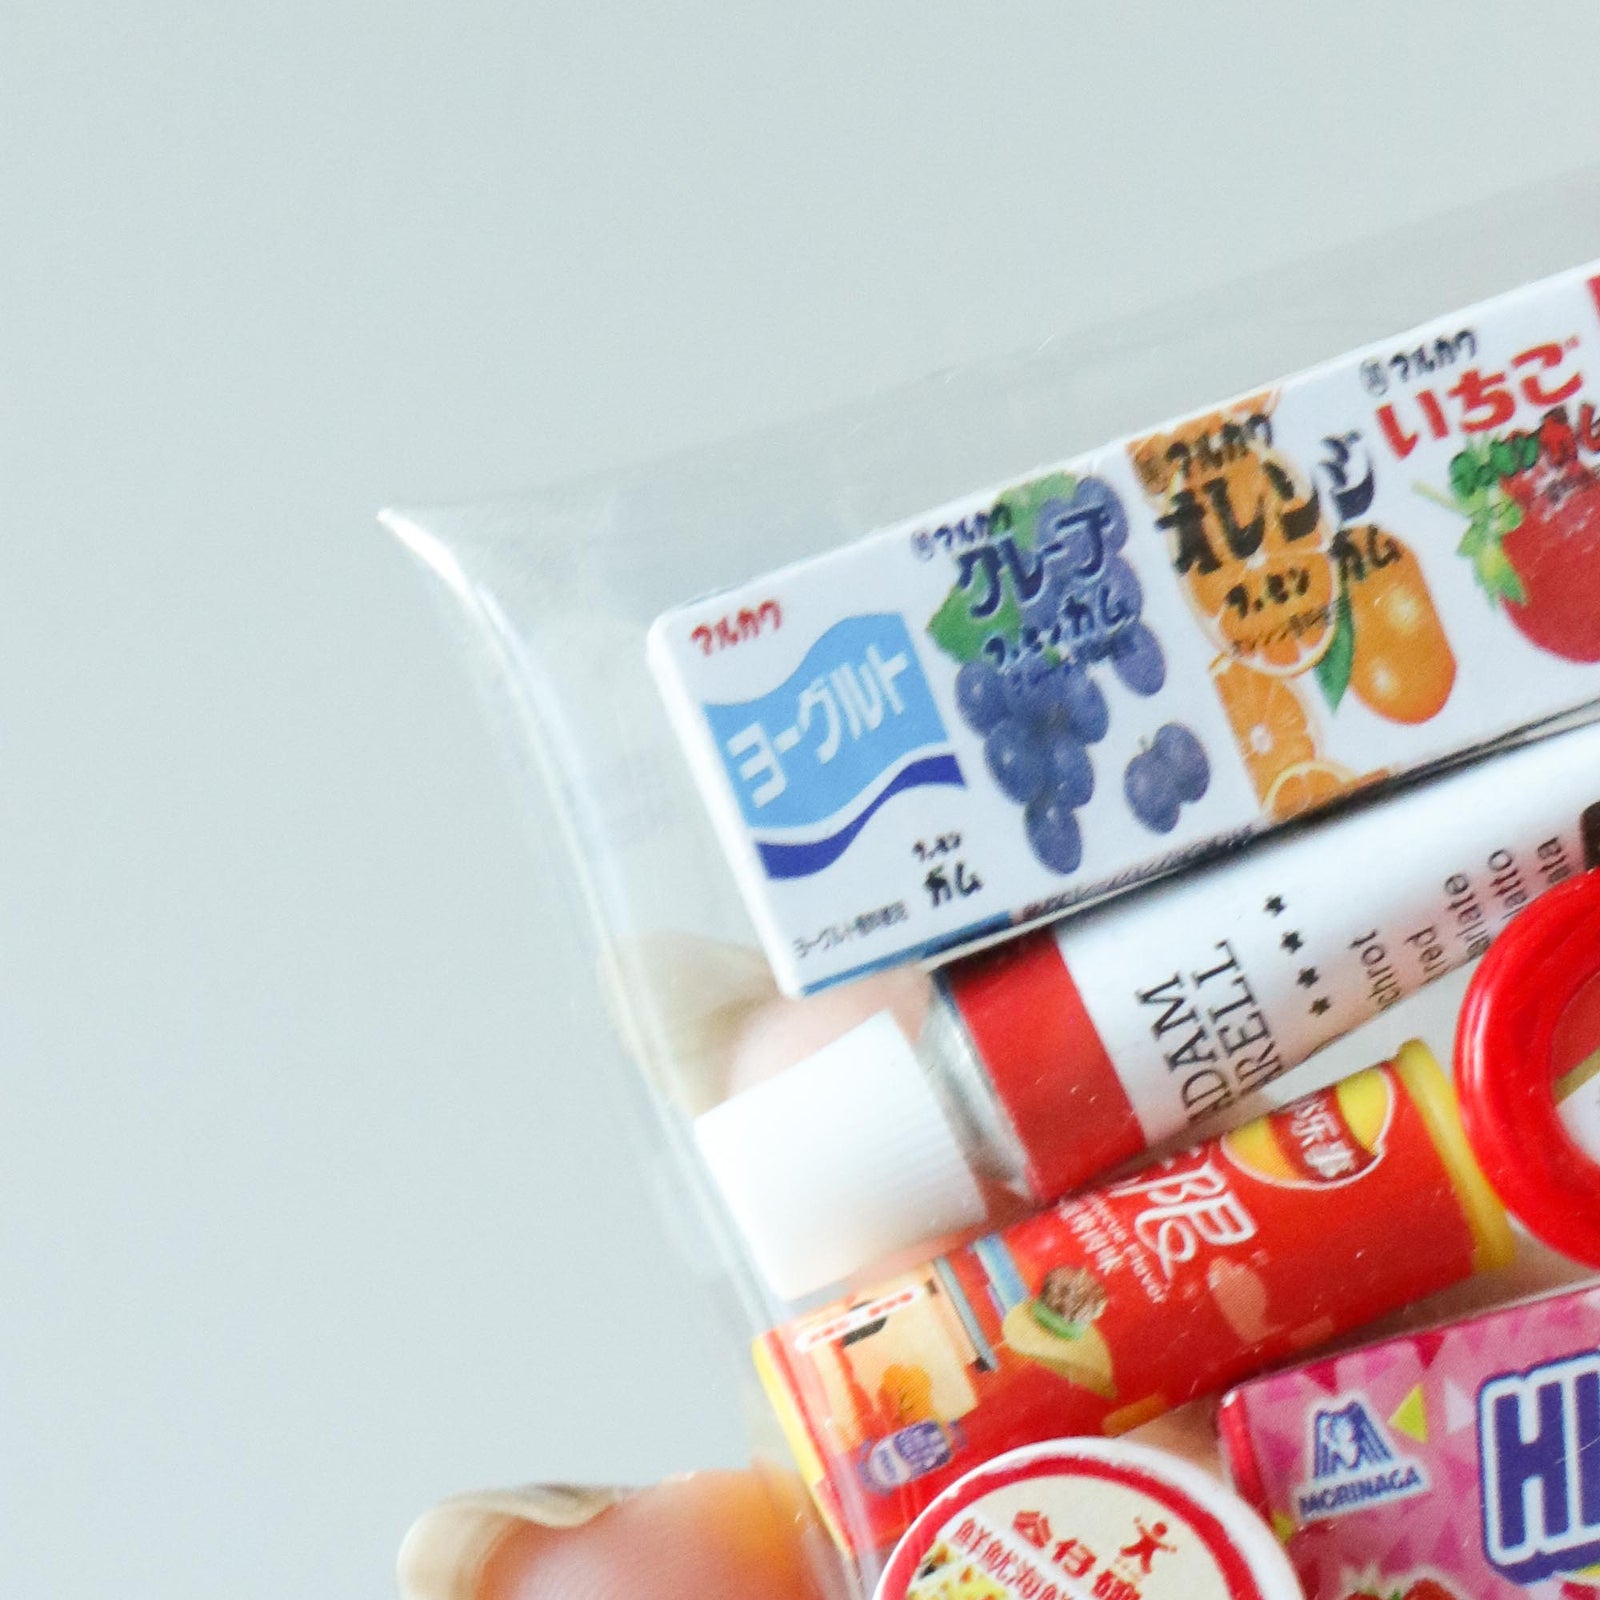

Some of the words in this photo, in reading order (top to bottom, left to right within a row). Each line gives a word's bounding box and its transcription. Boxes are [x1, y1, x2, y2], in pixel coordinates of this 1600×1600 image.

[1375, 335, 1584, 462] いちご
[1153, 428, 1376, 577] オレンジ
[690, 598, 783, 656] マルカワ
[726, 643, 911, 810] ヨーグルト
[923, 862, 984, 909] ガム
[1349, 928, 1402, 1011] chrot
[1299, 1464, 1423, 1517] MORINAGA
